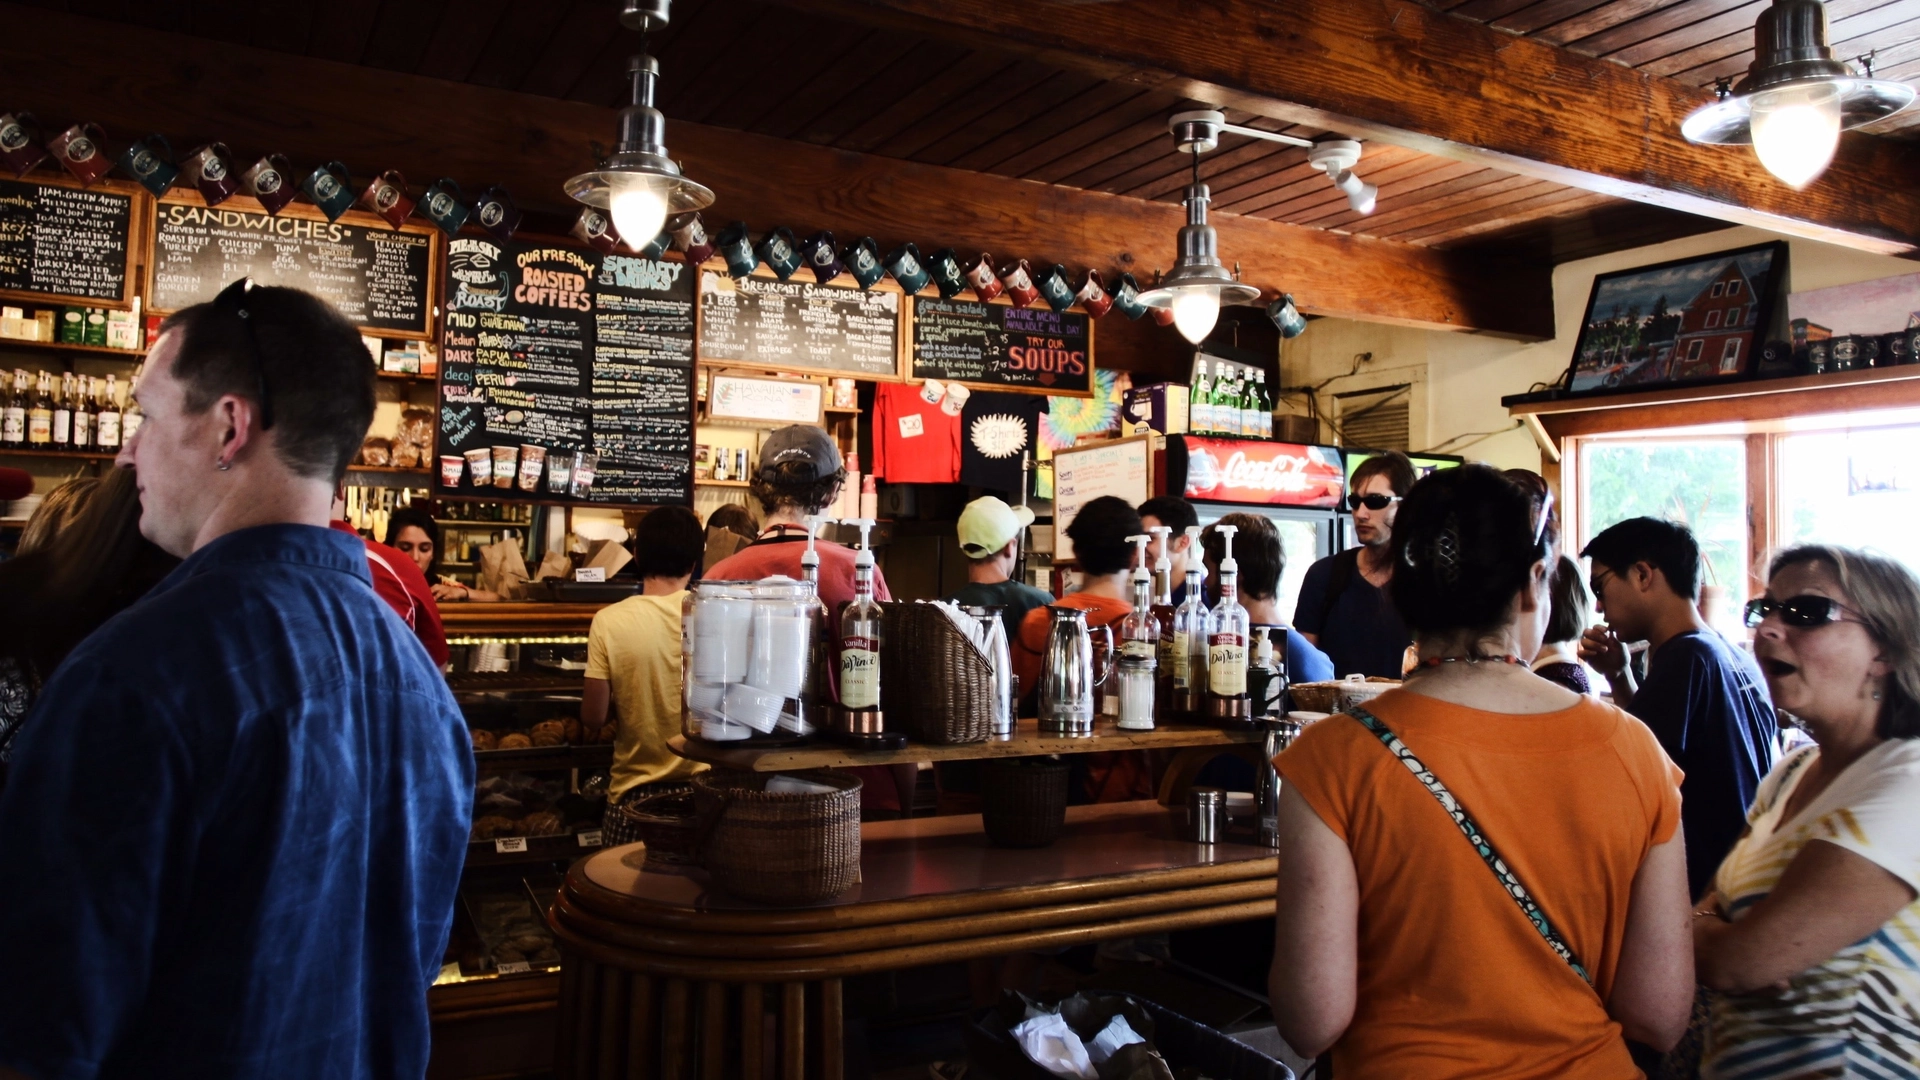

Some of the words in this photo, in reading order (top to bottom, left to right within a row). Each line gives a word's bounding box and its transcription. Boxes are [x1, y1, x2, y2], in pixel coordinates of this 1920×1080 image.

[56, 208, 84, 216] DIJON
[36, 213, 74, 224] TOASTED
[78, 218, 114, 228] WHEAT
[168, 206, 342, 242] SANDWICHES
[163, 224, 194, 234] SERVED
[74, 231, 110, 240] MELTED
[158, 233, 185, 244] ROAST
[188, 236, 210, 246] BEEF
[60, 244, 94, 253] ISLAND
[164, 243, 201, 253] TURKEY
[218, 238, 262, 250] CHICKEN
[274, 244, 301, 253] TUNA
[375, 240, 411, 249] LETTUCE
[34, 248, 74, 258] TOASTED
[83, 252, 104, 261] RYE
[221, 247, 256, 256] SALAD
[375, 246, 408, 255] TOMATO
[478, 241, 501, 261] SKY
[168, 255, 192, 263] HAM
[333, 256, 367, 264] AMERICAN
[376, 259, 409, 268] SPROUTS
[517, 250, 540, 268] OUR
[542, 249, 595, 279] FRESHLY
[72, 264, 109, 274] MELTED
[272, 261, 301, 271] SALAD
[372, 265, 405, 274] PICKLES
[602, 255, 683, 282] SPECIALTY
[157, 273, 201, 284] GARDEN
[309, 272, 356, 282] GUACAMOLE
[374, 277, 409, 286] CARROTS
[386, 273, 417, 282] PEPPERS
[523, 267, 585, 292] ROASTED
[615, 272, 672, 291] DRINKS
[90, 280, 117, 289] ISLAND
[157, 282, 200, 293] BURGER
[740, 276, 800, 295] BREAKFAST
[802, 283, 866, 302] SANDWICHES
[53, 285, 85, 295] TOASTED
[89, 288, 117, 298] BAGEL
[316, 286, 342, 294] BACON
[368, 297, 394, 305] HORSE
[456, 291, 507, 312] ROAST
[515, 285, 591, 312] COFFEES
[717, 296, 737, 306] EGG
[859, 303, 884, 311] BAGEL
[918, 299, 952, 315] garden
[956, 303, 987, 316] salads
[799, 310, 824, 318] FRENCH
[920, 314, 935, 324] leaf
[1005, 309, 1033, 320] ENTIRE
[1036, 312, 1061, 322] MENU
[447, 312, 476, 328] MILD
[704, 316, 737, 325] WHEAT
[802, 316, 839, 326] CROISSANT
[806, 326, 838, 335] POPOVER
[1006, 321, 1043, 332] AVAILABLE
[1049, 323, 1062, 333] ALL
[1067, 326, 1080, 334] DAY
[445, 331, 475, 346] Medium
[705, 331, 736, 339] SWEET
[756, 332, 788, 340] SAUSAGE
[846, 333, 865, 341] BAGEL
[926, 333, 949, 344] sprouts
[699, 341, 745, 351] SOURDOUGH
[1026, 336, 1045, 346] TRY
[1048, 339, 1065, 349] OUR
[809, 347, 832, 355] TOAST
[941, 345, 961, 353] scoop
[445, 348, 474, 363] DARK
[476, 348, 510, 360] PAPUA
[868, 355, 892, 365] WHITES
[477, 359, 497, 367] NEW
[498, 359, 528, 369] GUINEA
[921, 360, 936, 368] chef
[938, 360, 953, 370] style
[1008, 346, 1085, 376] SOUPS
[445, 366, 474, 386] decaf
[475, 373, 505, 387] PERU
[488, 387, 526, 398] ETHIOPIAN
[734, 382, 792, 396] HAWAIIAN
[742, 395, 783, 403] KONA
[902, 418, 920, 430] $20
[449, 420, 476, 446] ORGANIC
[980, 427, 1020, 440] T-Shirts
[992, 439, 1006, 450] $15
[595, 448, 613, 457] TEA
[1224, 451, 1314, 492] Coca-Cola
[845, 638, 867, 648] Vanilla
[1211, 650, 1244, 664] DaVinci
[842, 655, 876, 672] DaVinci
